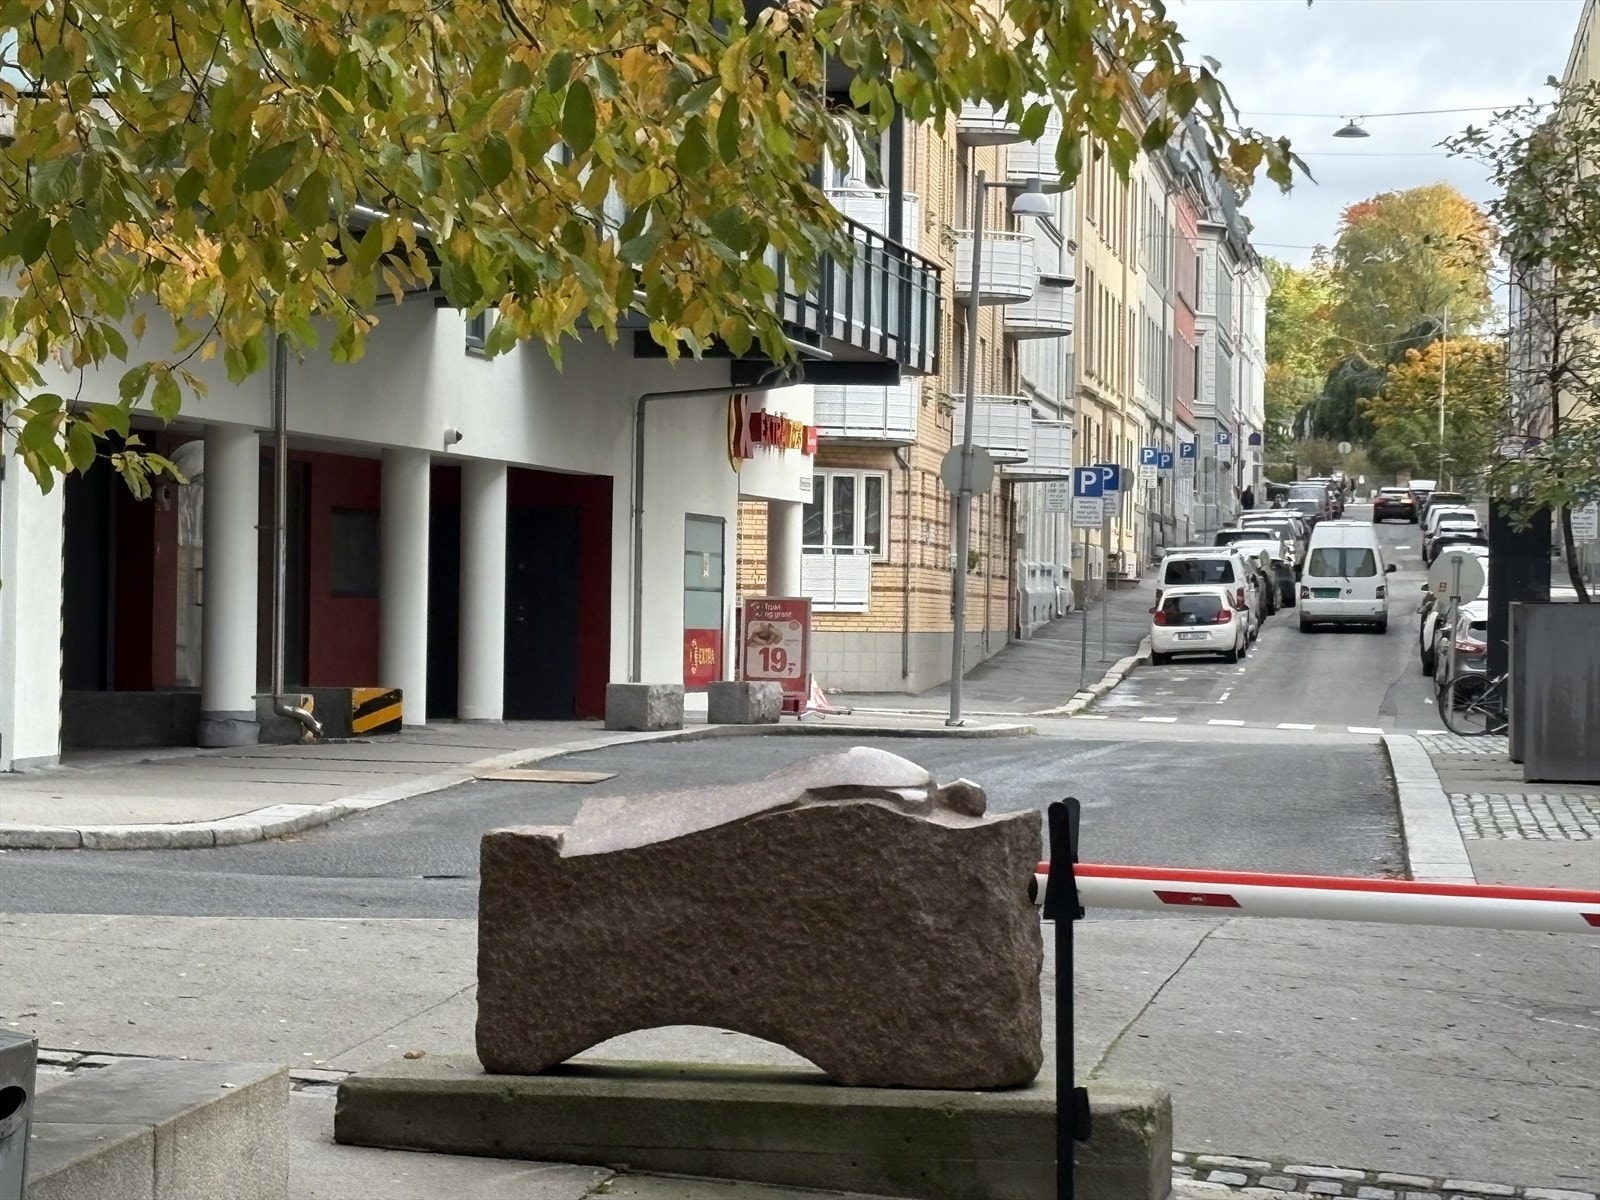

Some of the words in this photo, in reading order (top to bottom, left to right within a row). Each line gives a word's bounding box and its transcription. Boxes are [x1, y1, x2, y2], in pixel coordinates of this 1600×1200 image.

[1219, 434, 1228, 443] P
[1143, 450, 1154, 463] P
[1183, 445, 1192, 456] P
[1161, 454, 1171, 467] P
[1103, 467, 1114, 482] P
[1080, 471, 1097, 494] P
